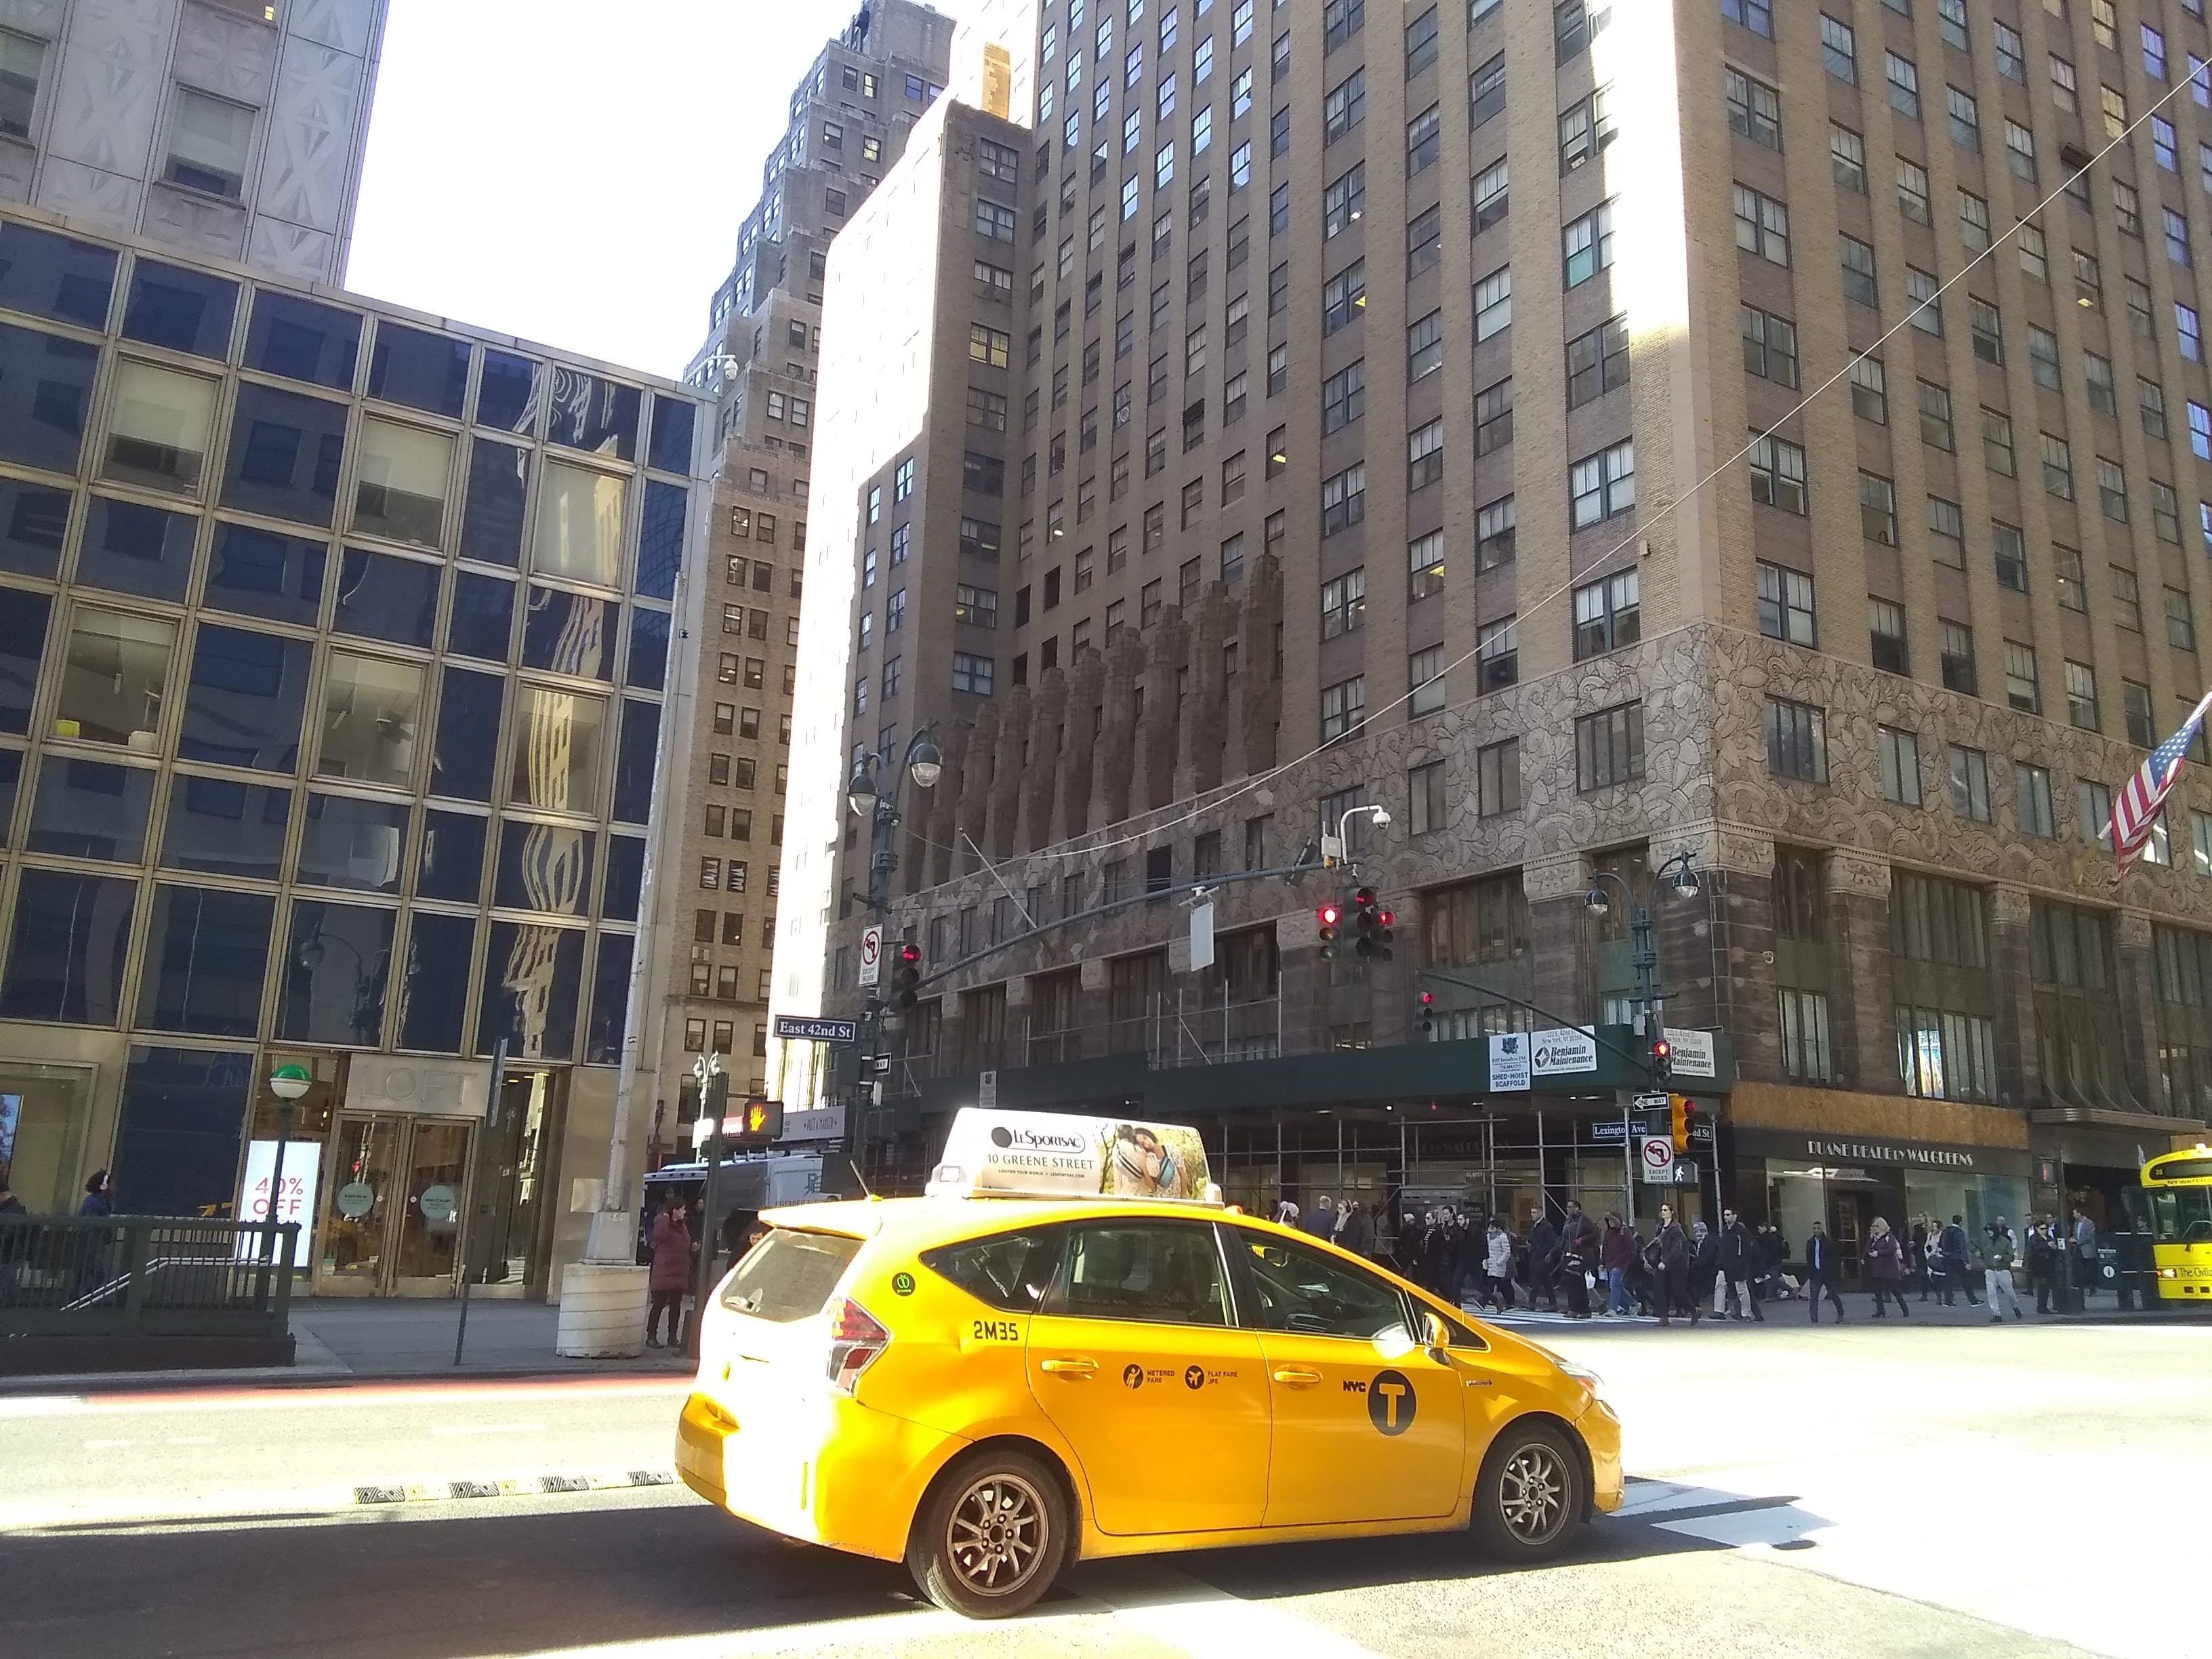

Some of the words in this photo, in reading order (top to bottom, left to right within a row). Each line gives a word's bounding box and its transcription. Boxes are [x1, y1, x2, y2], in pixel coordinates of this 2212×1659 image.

[780, 1021, 805, 1034] East
[808, 1024, 836, 1037] 42nd
[839, 1027, 851, 1038] St
[1551, 1044, 1586, 1057] Benjamin
[1672, 1046, 1706, 1059] Benjamin
[1549, 1054, 1593, 1066] Maintenance
[360, 1065, 477, 1105] LOFT
[1495, 1080, 1525, 1088] SCAFFOLD
[1594, 1126, 1626, 1136] Lexingto
[1631, 1124, 1645, 1134] Ave
[1702, 1129, 1710, 1139] St
[1807, 1141, 1849, 1157] DUANE
[1852, 1145, 1893, 1160] READE
[1906, 1149, 1973, 1166] WALGREENS
[988, 1153, 999, 1164] 10
[1002, 1155, 1048, 1167] GREENE
[1052, 1158, 1094, 1170] STREET
[973, 1321, 1019, 1340] 2M35
[1343, 1380, 1366, 1393] NYC
[1378, 1382, 1406, 1428] T
